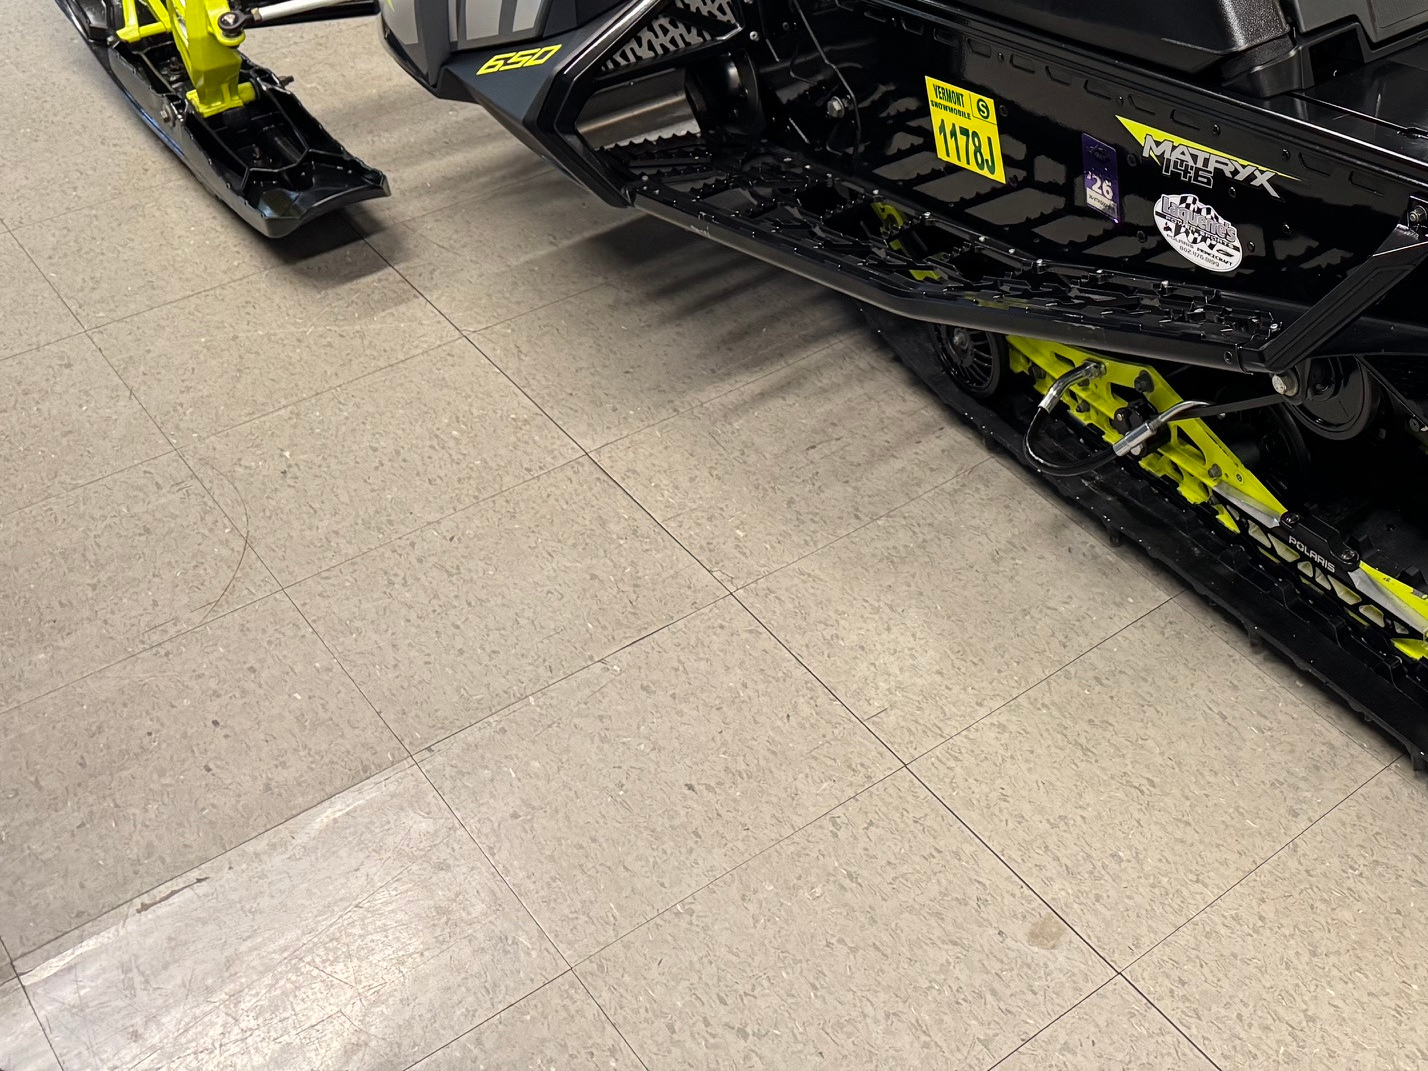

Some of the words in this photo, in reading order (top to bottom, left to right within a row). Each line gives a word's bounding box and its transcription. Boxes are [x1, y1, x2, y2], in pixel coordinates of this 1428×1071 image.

[476, 44, 562, 75] 650
[930, 99, 971, 120] SNOWMOBILE
[933, 83, 964, 108] VERMONT
[938, 118, 996, 175] 1178J
[1142, 134, 1280, 199] MATRYX
[1162, 156, 1213, 189] 146
[1161, 195, 1236, 243] Laquerre's
[1288, 535, 1335, 573] POLARIS
